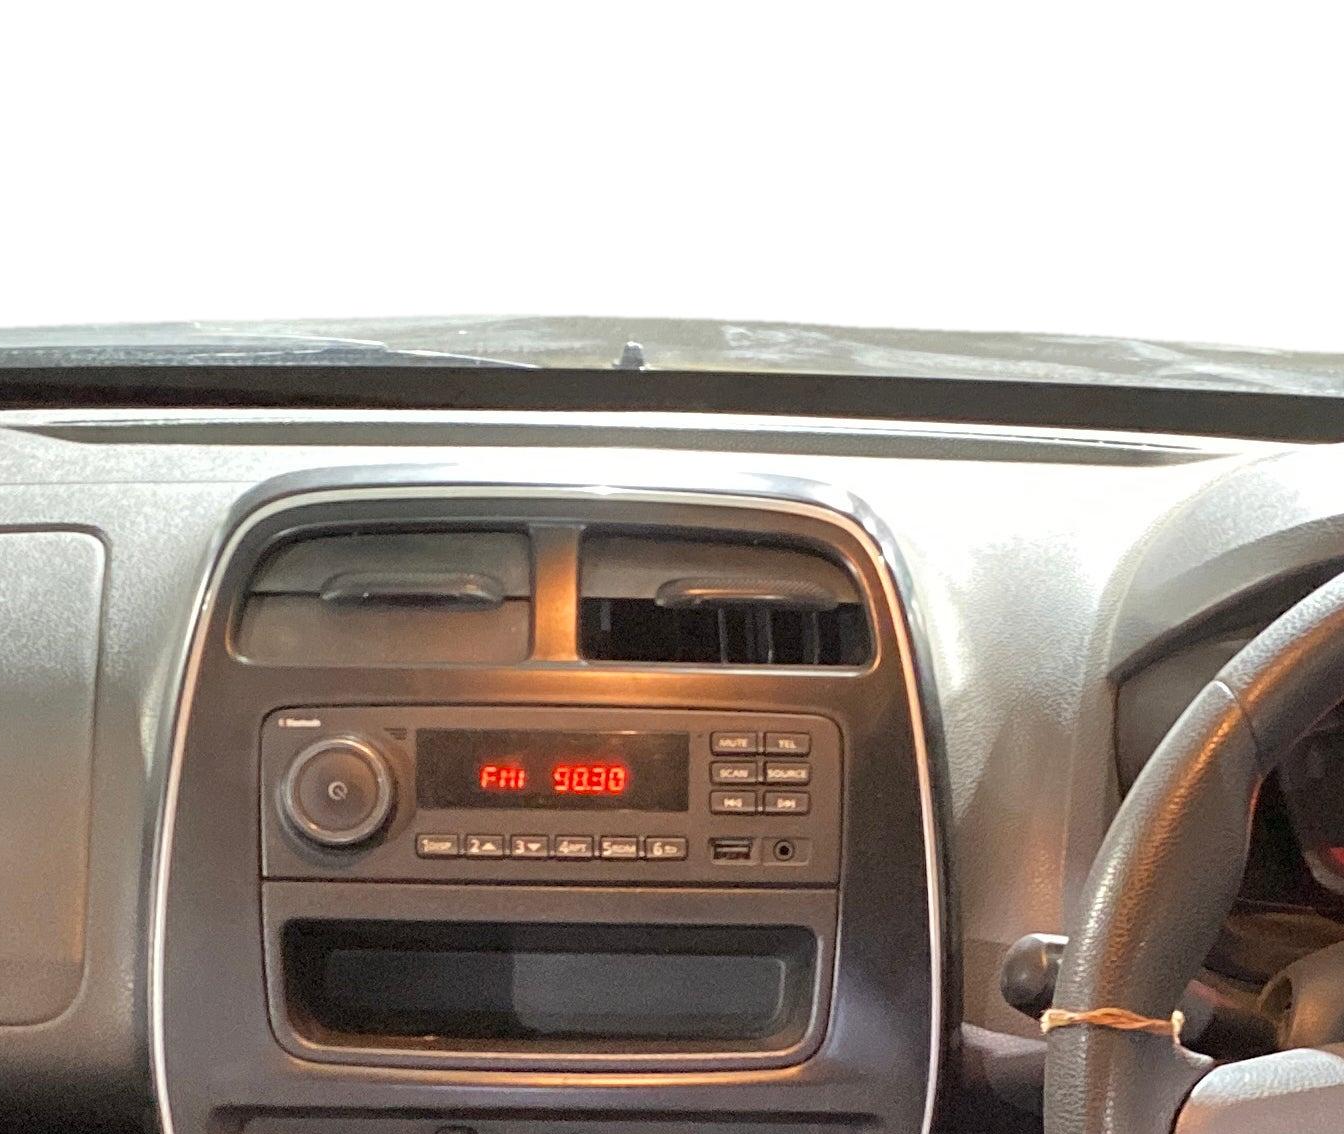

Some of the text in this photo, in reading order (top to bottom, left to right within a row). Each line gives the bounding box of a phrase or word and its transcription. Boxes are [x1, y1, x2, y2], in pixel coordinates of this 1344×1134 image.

[470, 839, 481, 853] 2
[515, 840, 526, 854] 3
[652, 841, 664, 856] 6
